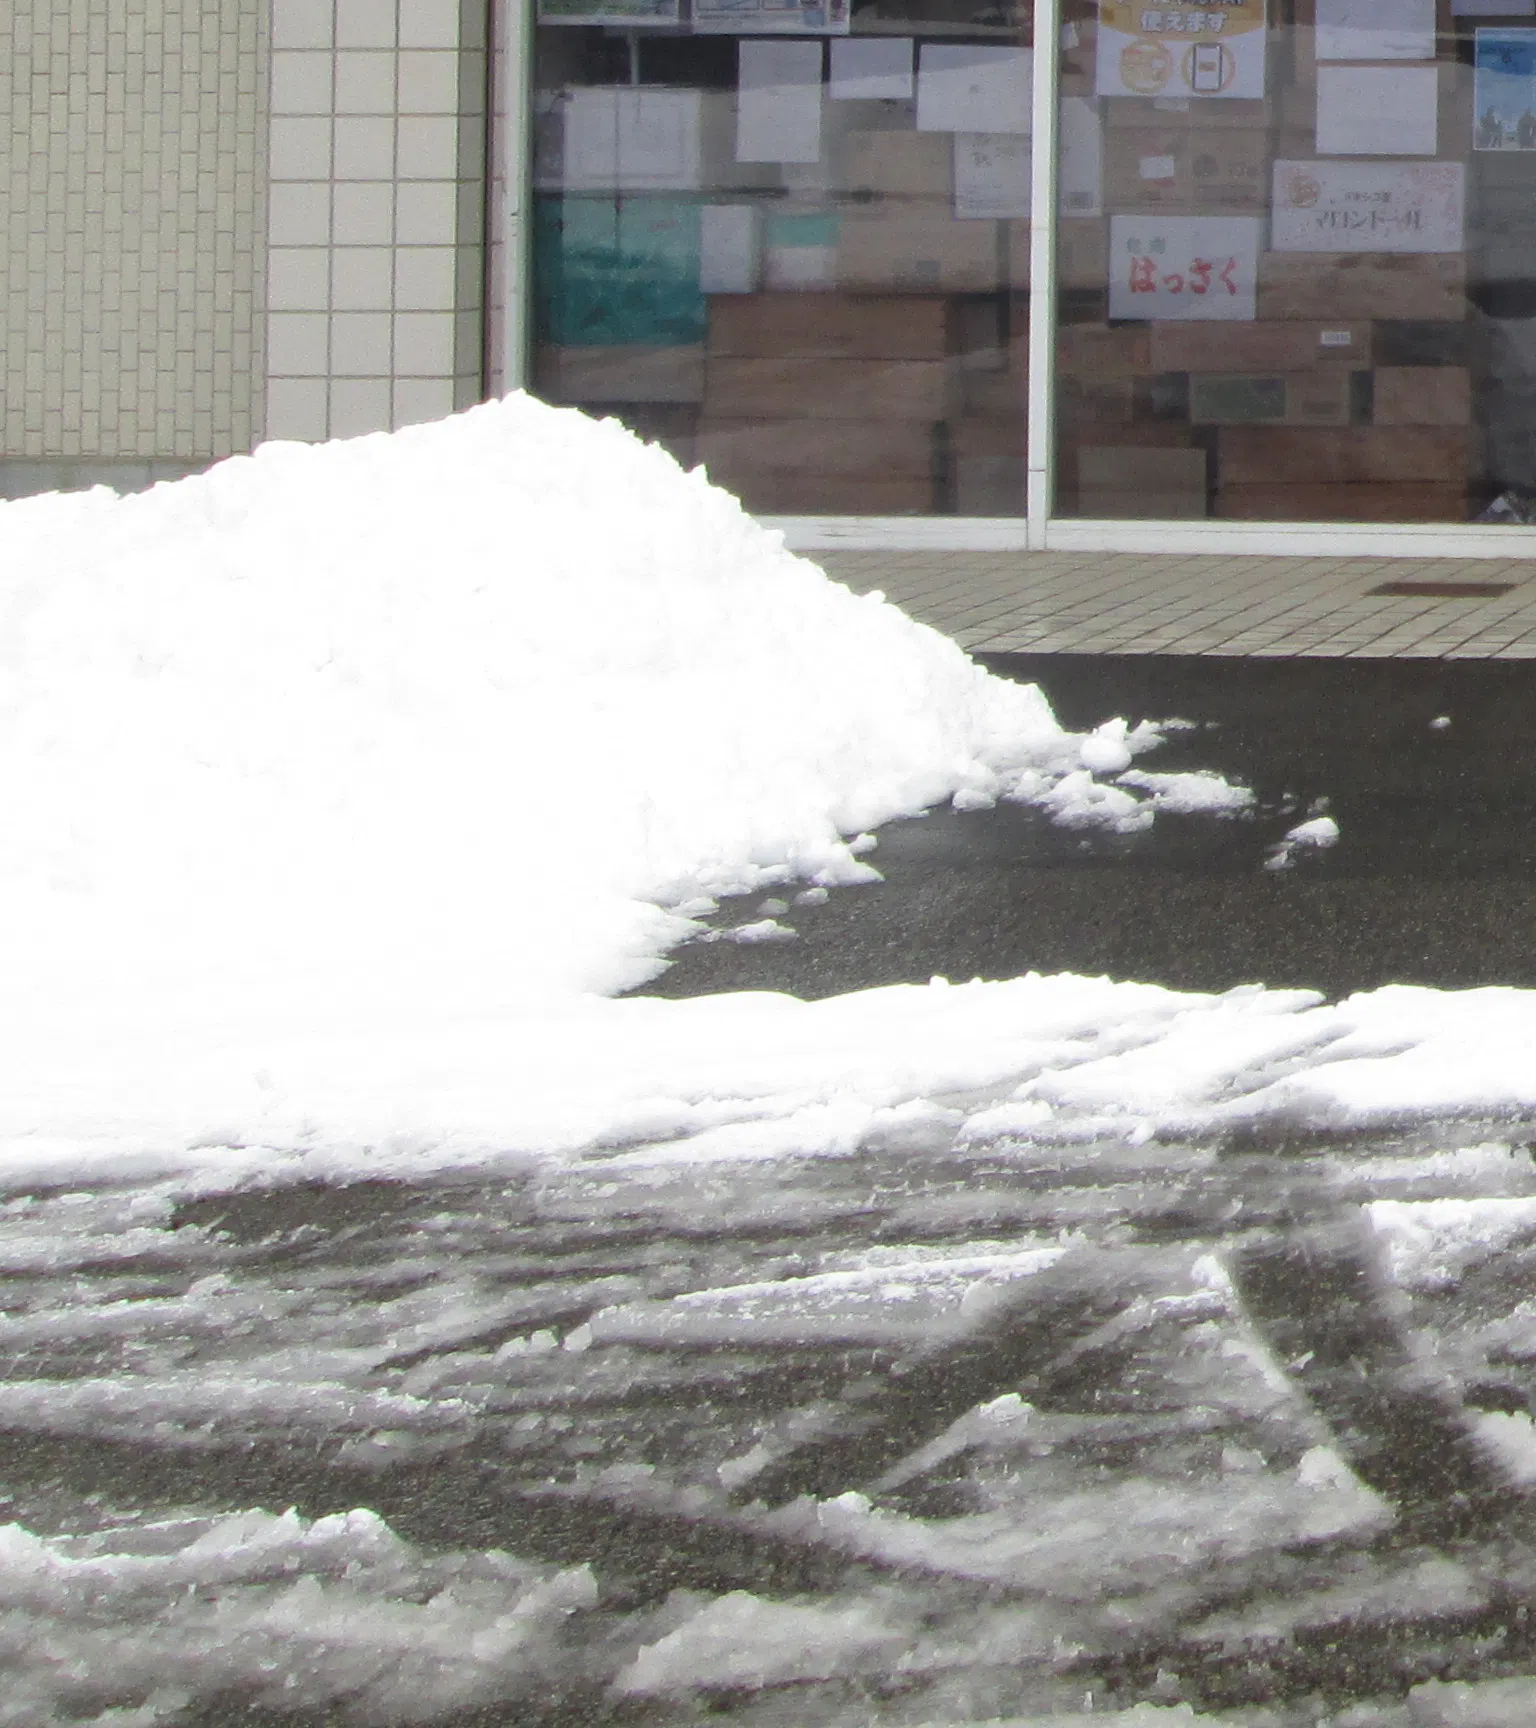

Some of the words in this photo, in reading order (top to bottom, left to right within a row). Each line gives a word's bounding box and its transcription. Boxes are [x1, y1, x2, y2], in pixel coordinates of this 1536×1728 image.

[1139, 9, 1229, 33] 使えます
[1128, 255, 1240, 297] はっさく
